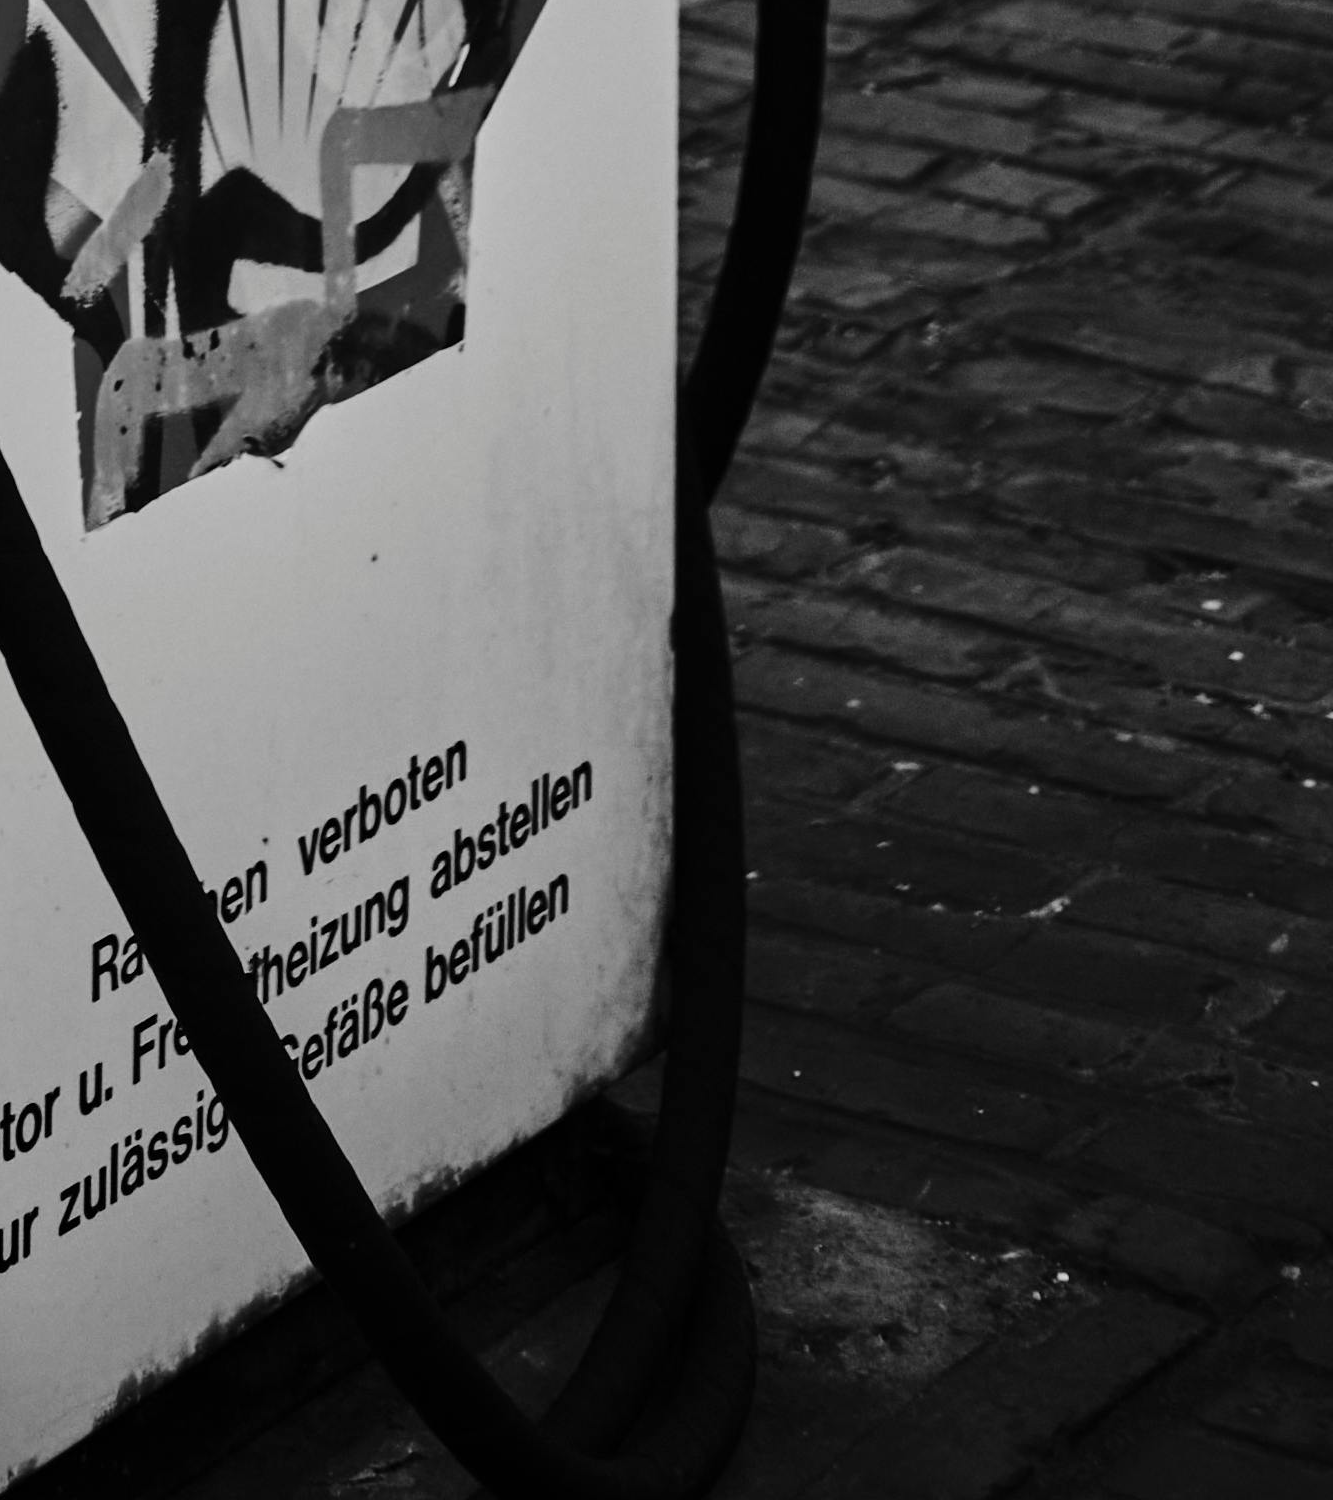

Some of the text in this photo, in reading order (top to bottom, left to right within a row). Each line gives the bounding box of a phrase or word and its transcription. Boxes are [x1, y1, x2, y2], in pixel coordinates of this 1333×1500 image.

[78, 1061, 114, 1117] u.
[430, 759, 593, 899] abstellen
[91, 738, 468, 1002] Raen verboten
[59, 1086, 231, 1237] zulässig
[425, 872, 570, 1005] befüllen
